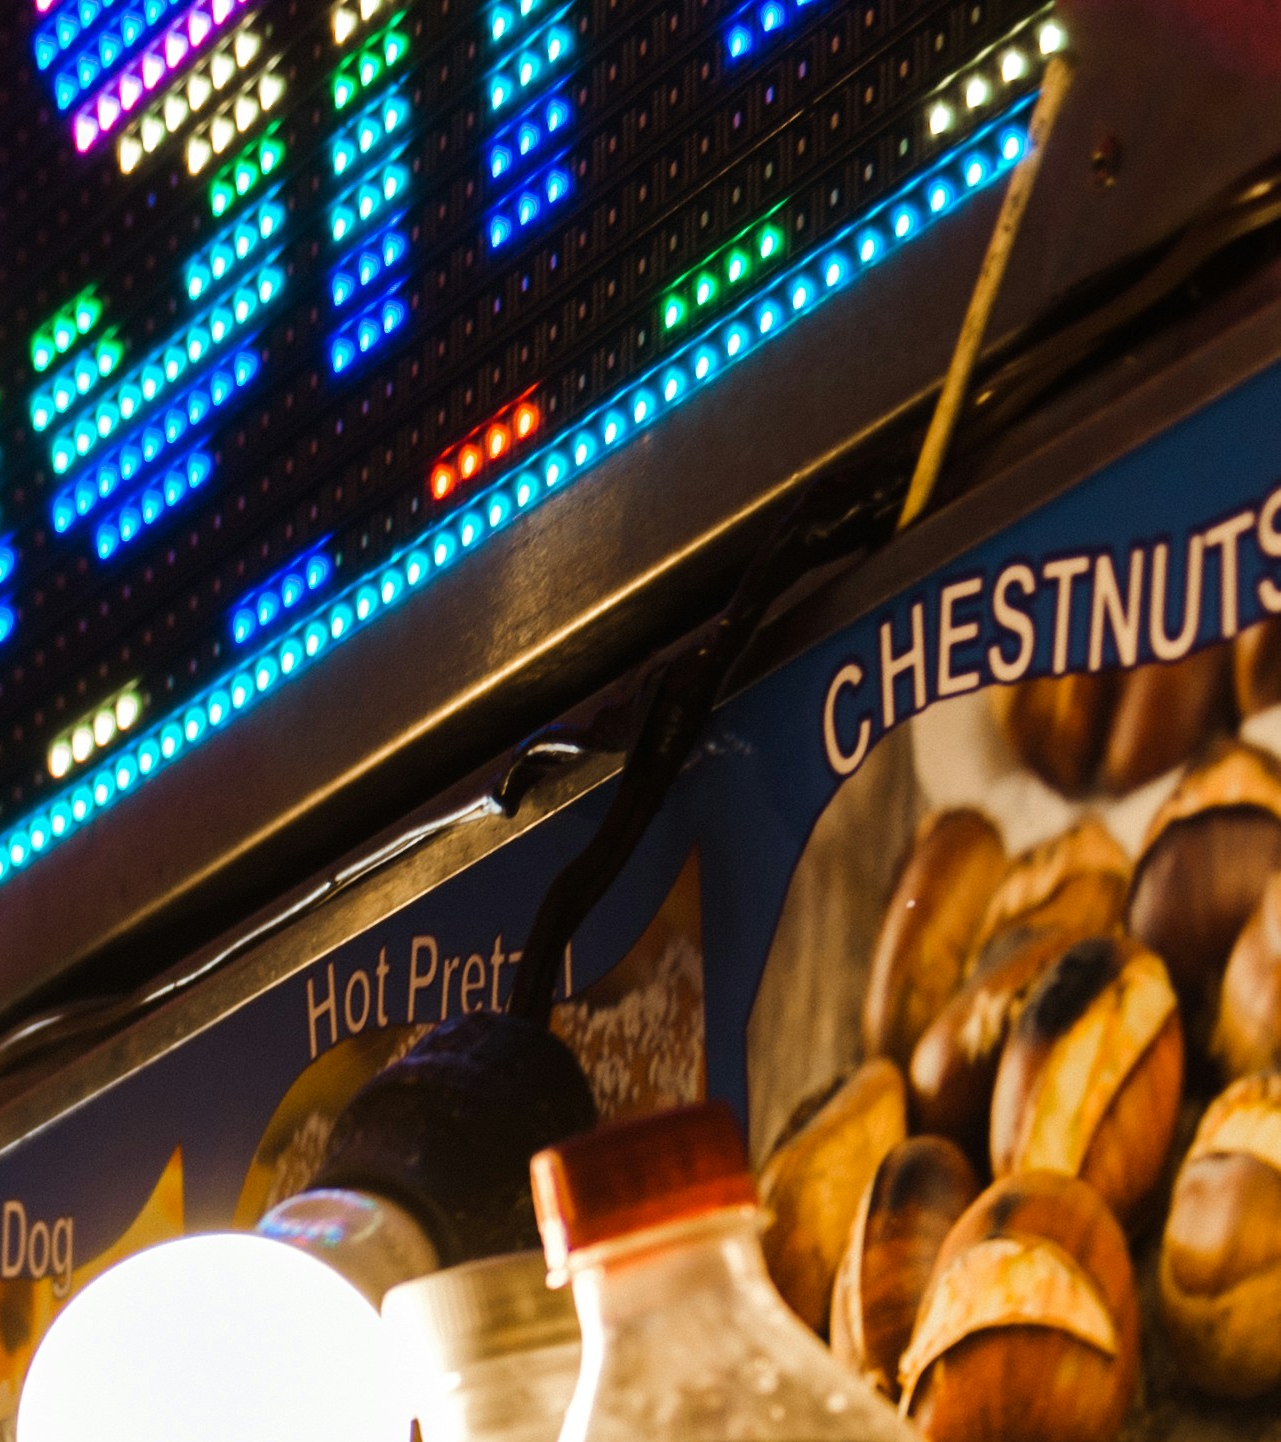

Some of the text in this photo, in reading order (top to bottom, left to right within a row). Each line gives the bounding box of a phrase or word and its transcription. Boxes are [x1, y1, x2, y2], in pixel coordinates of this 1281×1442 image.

[306, 933, 573, 1060] Hot Pretl
[1, 1199, 74, 1298] Dog
